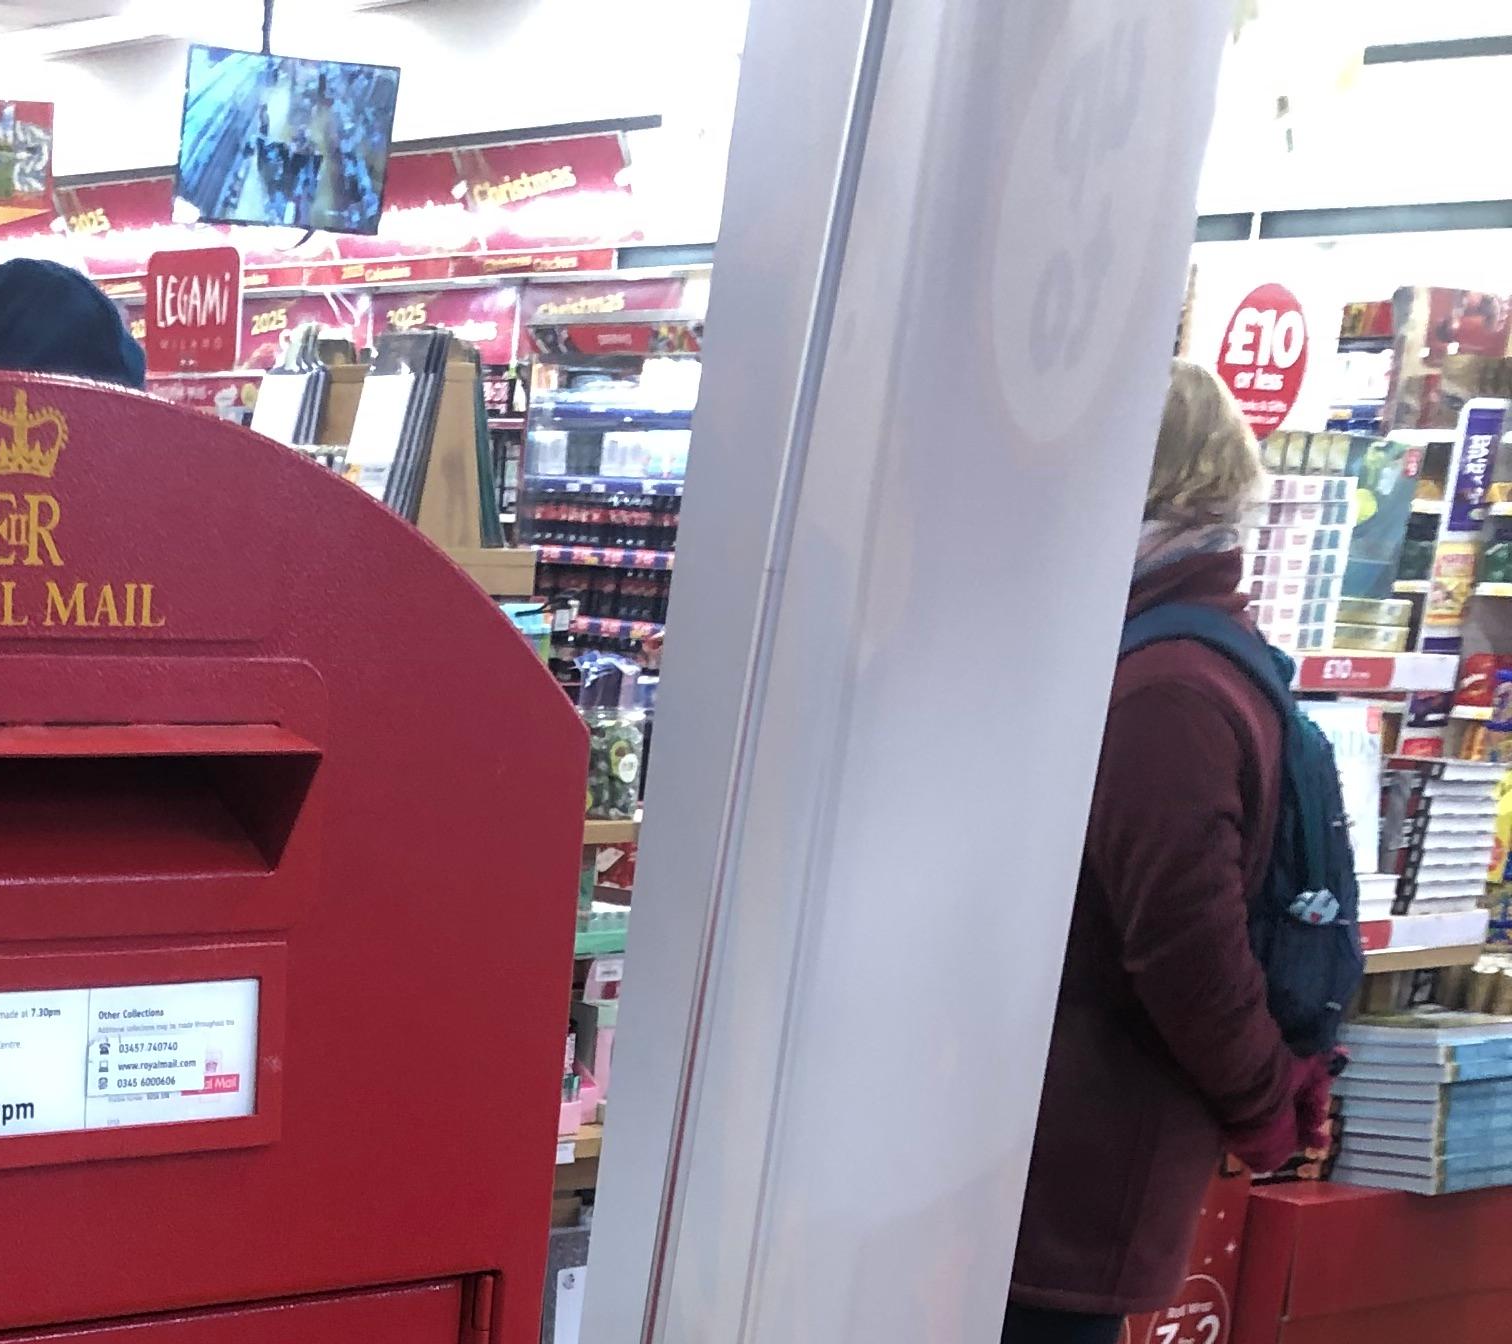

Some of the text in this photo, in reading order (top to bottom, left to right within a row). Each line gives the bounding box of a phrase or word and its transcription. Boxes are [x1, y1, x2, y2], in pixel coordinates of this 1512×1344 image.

[1224, 306, 1305, 369] £10
[1253, 367, 1285, 391] less
[42, 580, 166, 627] MAIL
[98, 1008, 164, 1020] Other Collections
[118, 1059, 196, 1071] www.royalmail.com
[215, 1075, 237, 1089] Mail
